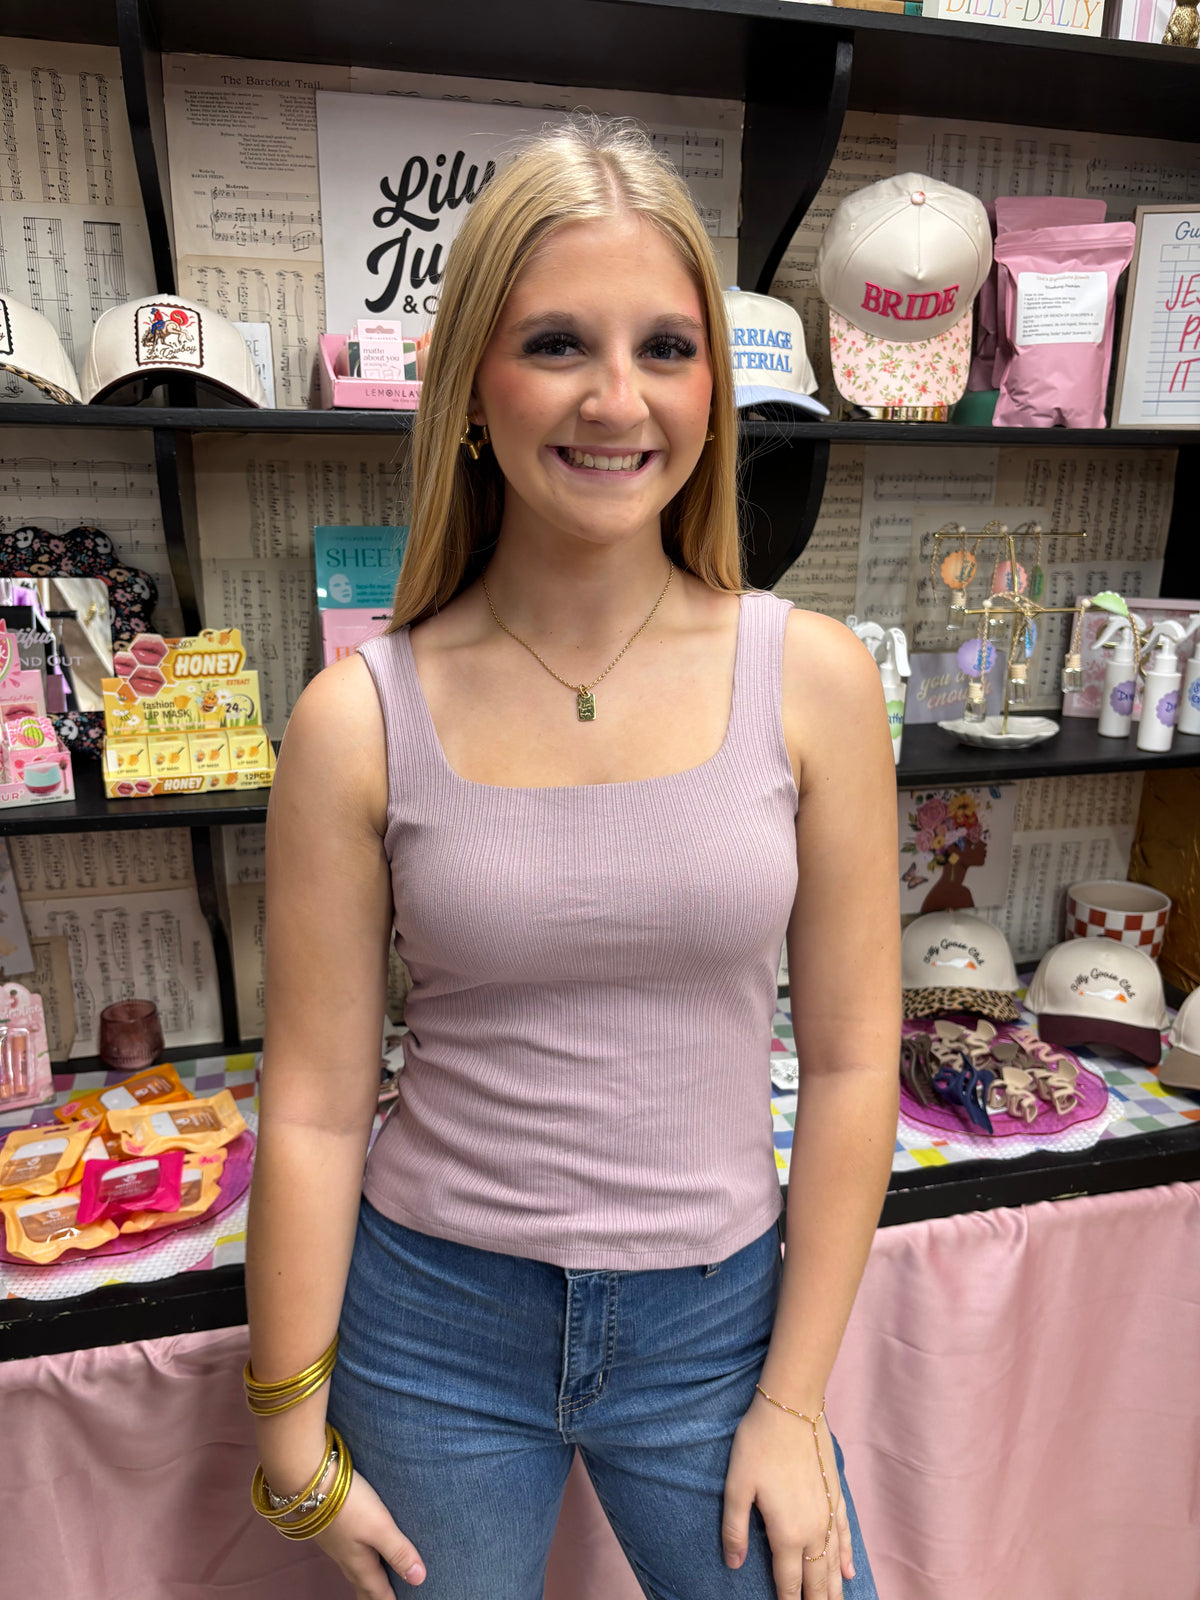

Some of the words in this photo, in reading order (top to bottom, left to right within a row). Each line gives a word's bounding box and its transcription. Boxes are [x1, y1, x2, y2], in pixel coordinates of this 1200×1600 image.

[221, 75, 241, 85] The
[246, 76, 290, 87] Barefoot
[861, 281, 960, 321] BRIDE
[1165, 273, 1200, 311] JE
[403, 294, 419, 314] &
[729, 328, 793, 350] RRIAGE
[160, 341, 197, 358] Cowboy
[386, 355, 400, 363] you
[730, 352, 793, 373] TERIAL
[47, 655, 84, 667] OUT
[174, 651, 241, 677] HONEY
[226, 678, 250, 686] EXTRACT
[916, 673, 951, 700] you
[142, 701, 175, 710] fashion
[928, 680, 992, 711] enouh
[144, 711, 159, 720] LIP
[163, 709, 190, 719] MASK
[163, 777, 203, 791] HONEY
[244, 772, 271, 780] 12PCS
[968, 946, 985, 967] Club
[1119, 978, 1136, 999] Club
